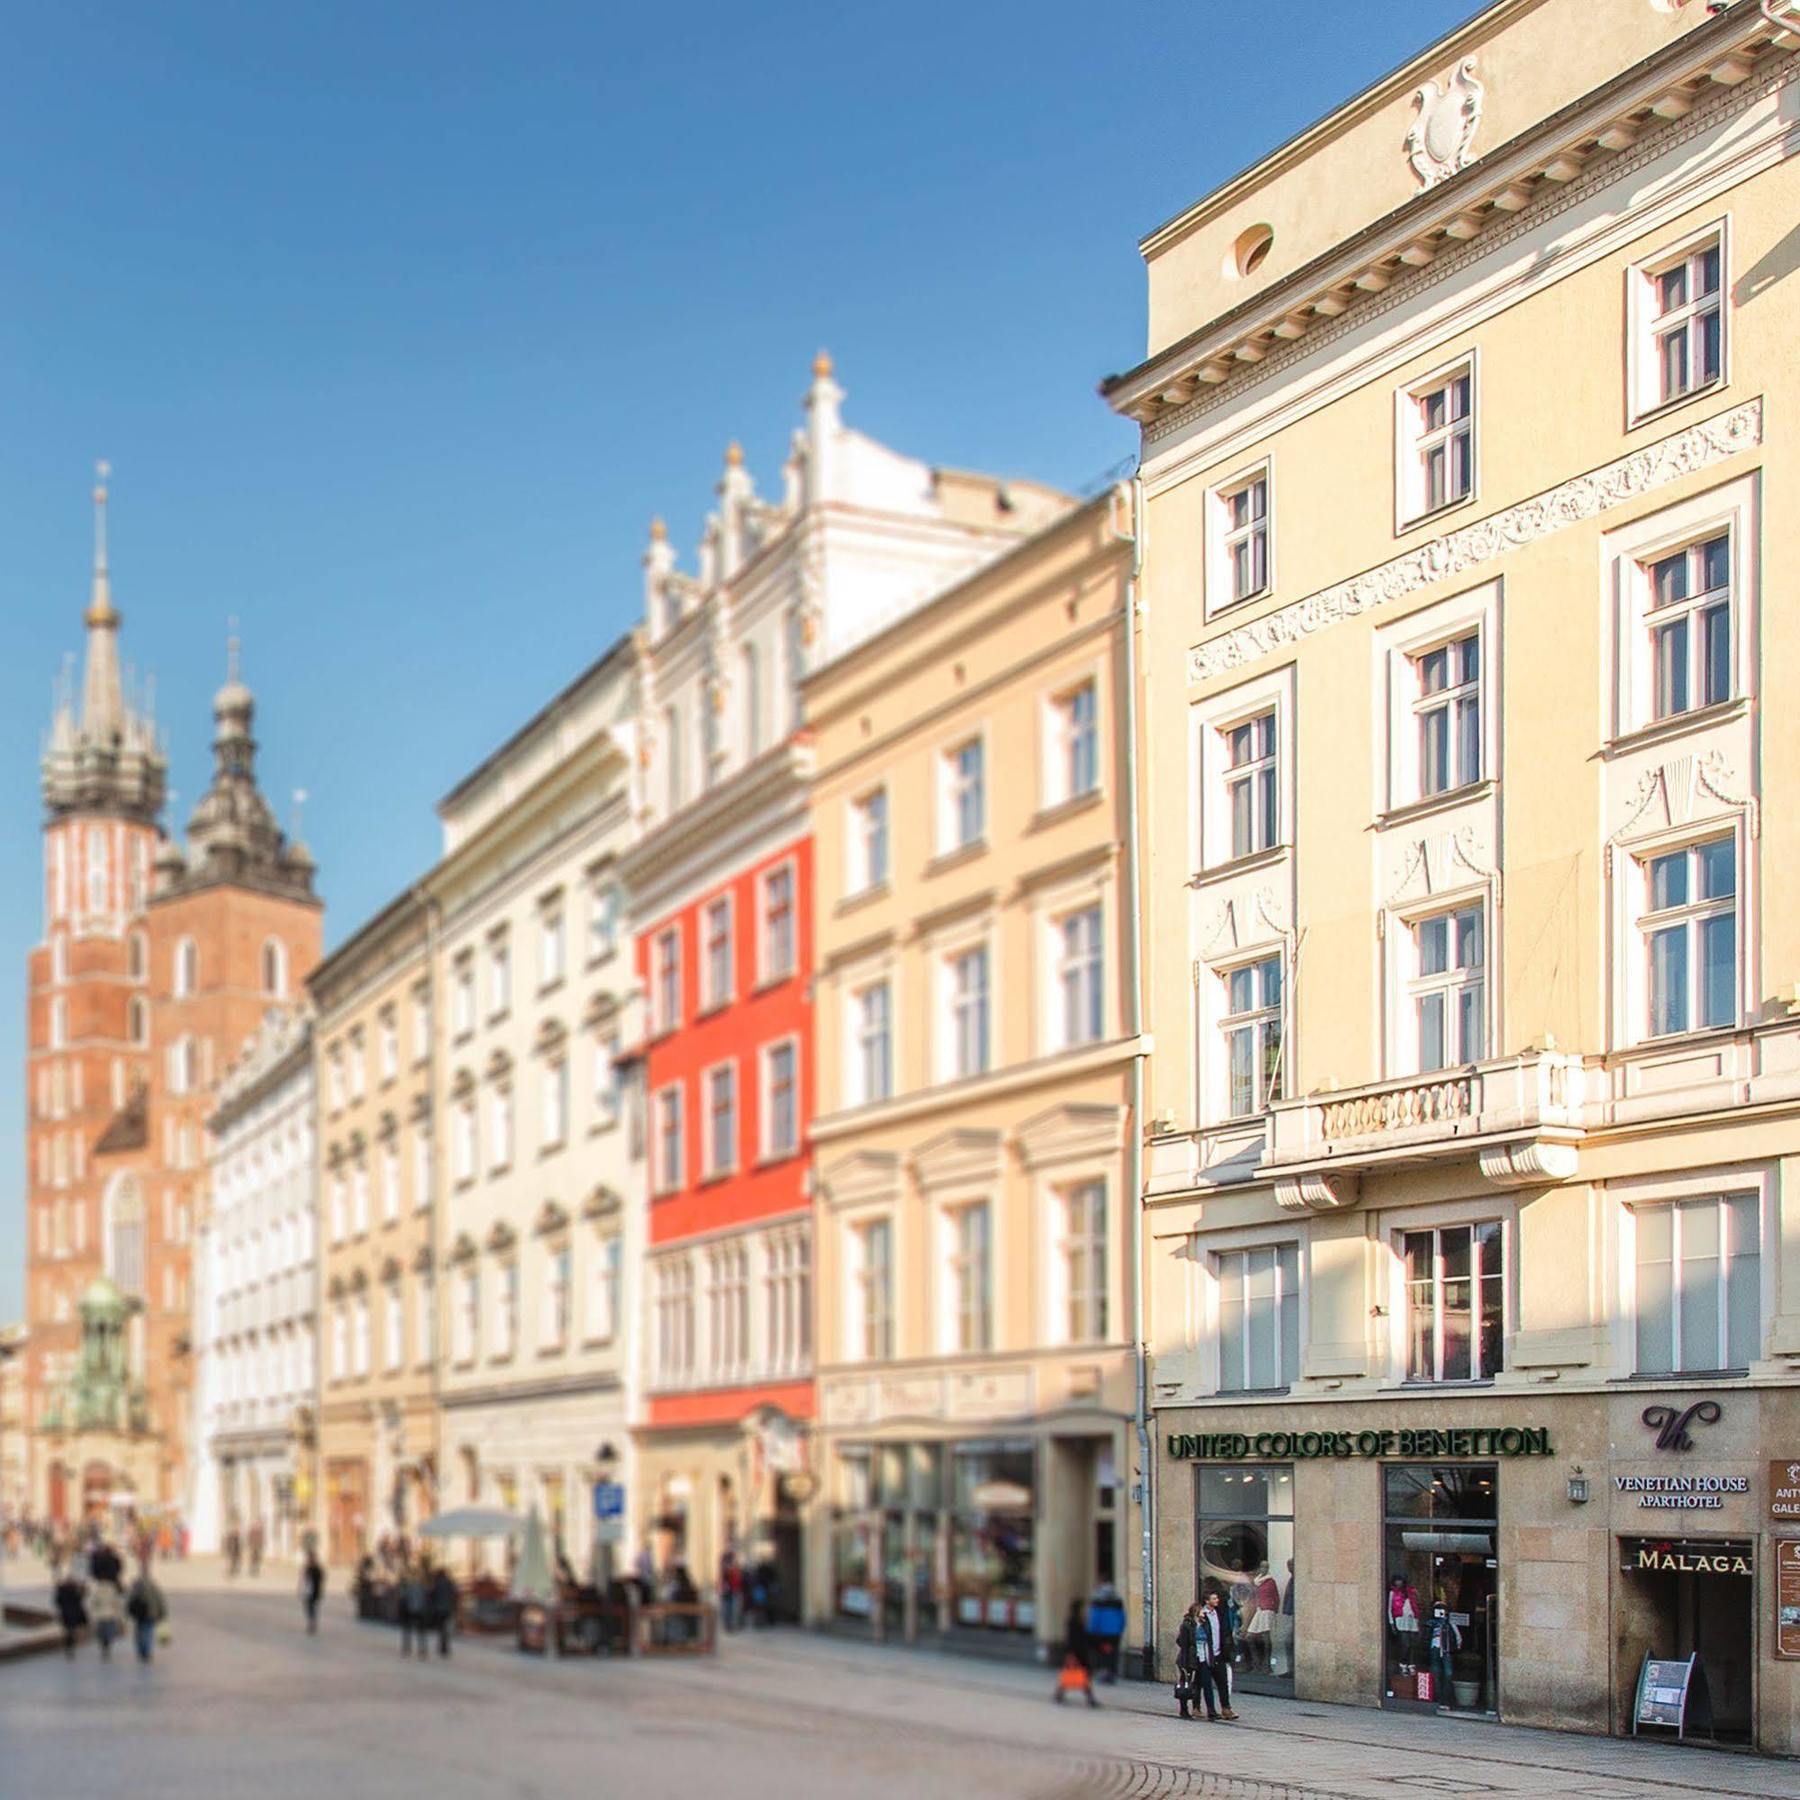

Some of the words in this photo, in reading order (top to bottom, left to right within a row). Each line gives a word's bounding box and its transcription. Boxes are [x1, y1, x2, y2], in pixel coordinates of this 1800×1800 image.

[1167, 1433, 1248, 1458] UNITED
[1254, 1431, 1352, 1459] COLORS
[1356, 1430, 1394, 1456] OF
[1615, 1477, 1692, 1491] VENETIAN
[1696, 1477, 1748, 1492] HOUSE
[1638, 1496, 1721, 1508] APARTHOTEL
[1639, 1550, 1748, 1572] MALAGA
